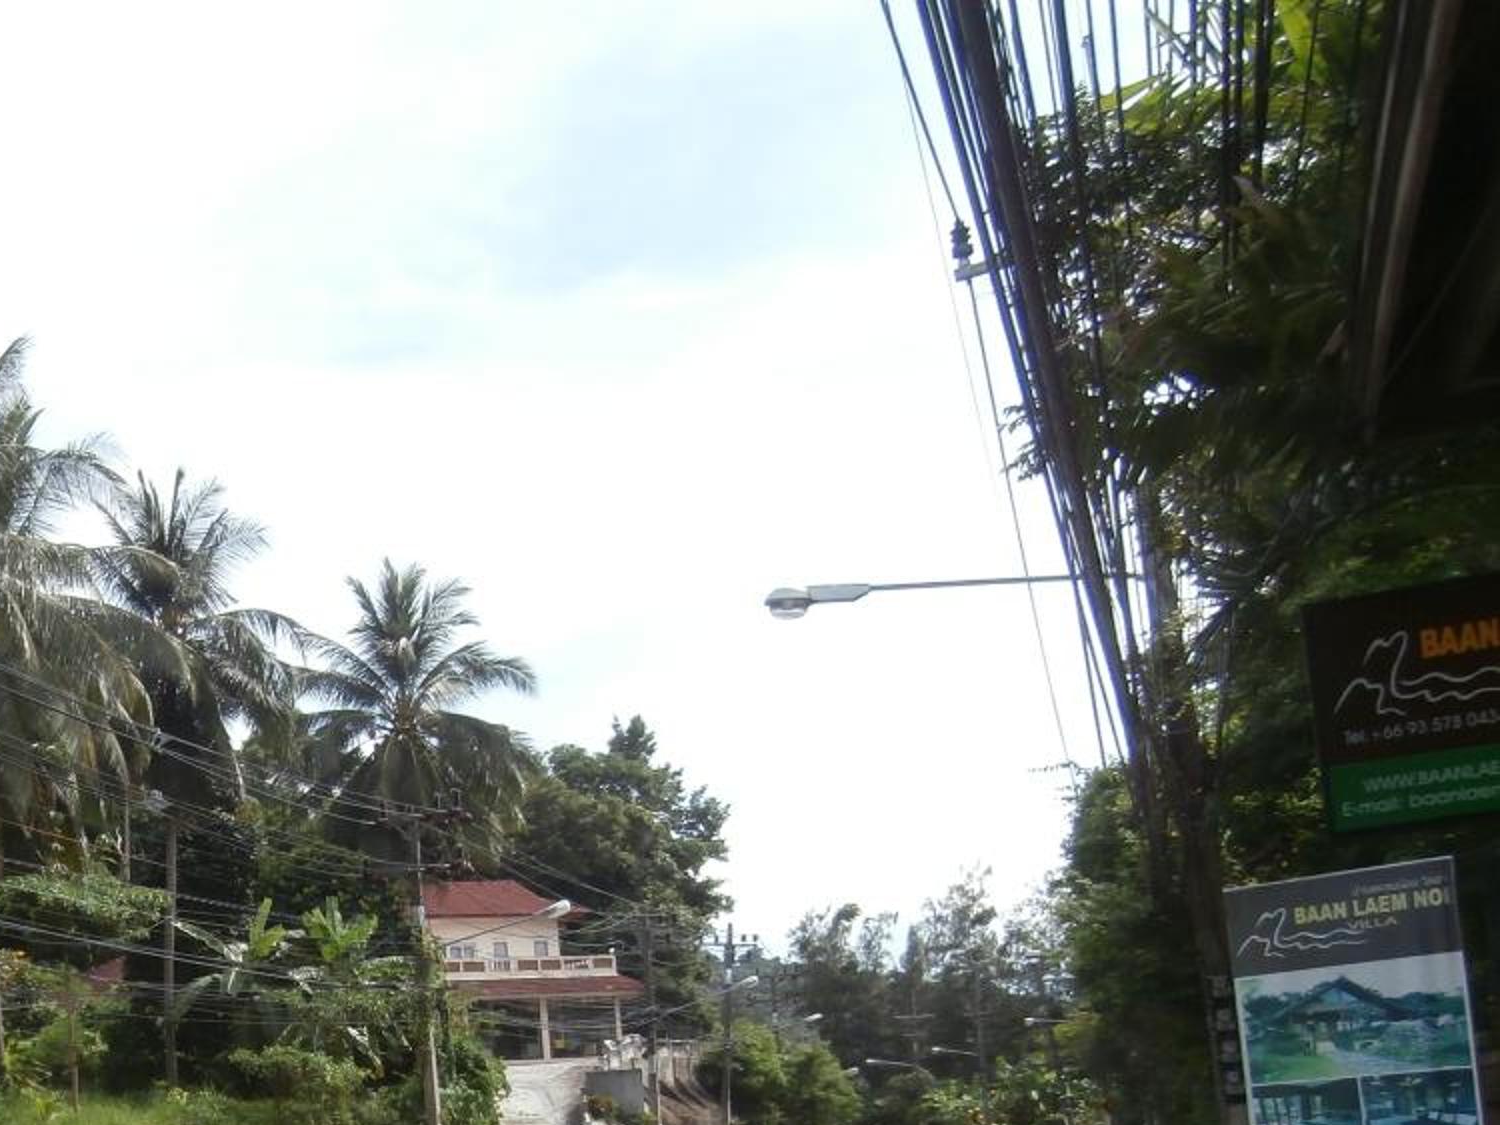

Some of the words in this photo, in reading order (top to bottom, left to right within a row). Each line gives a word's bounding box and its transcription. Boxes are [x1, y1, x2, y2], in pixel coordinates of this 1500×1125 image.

[1419, 617, 1500, 659] BAAN
[1293, 900, 1349, 926] BAAN
[1352, 892, 1408, 917] LAEM
[1347, 915, 1397, 930] VILLA
